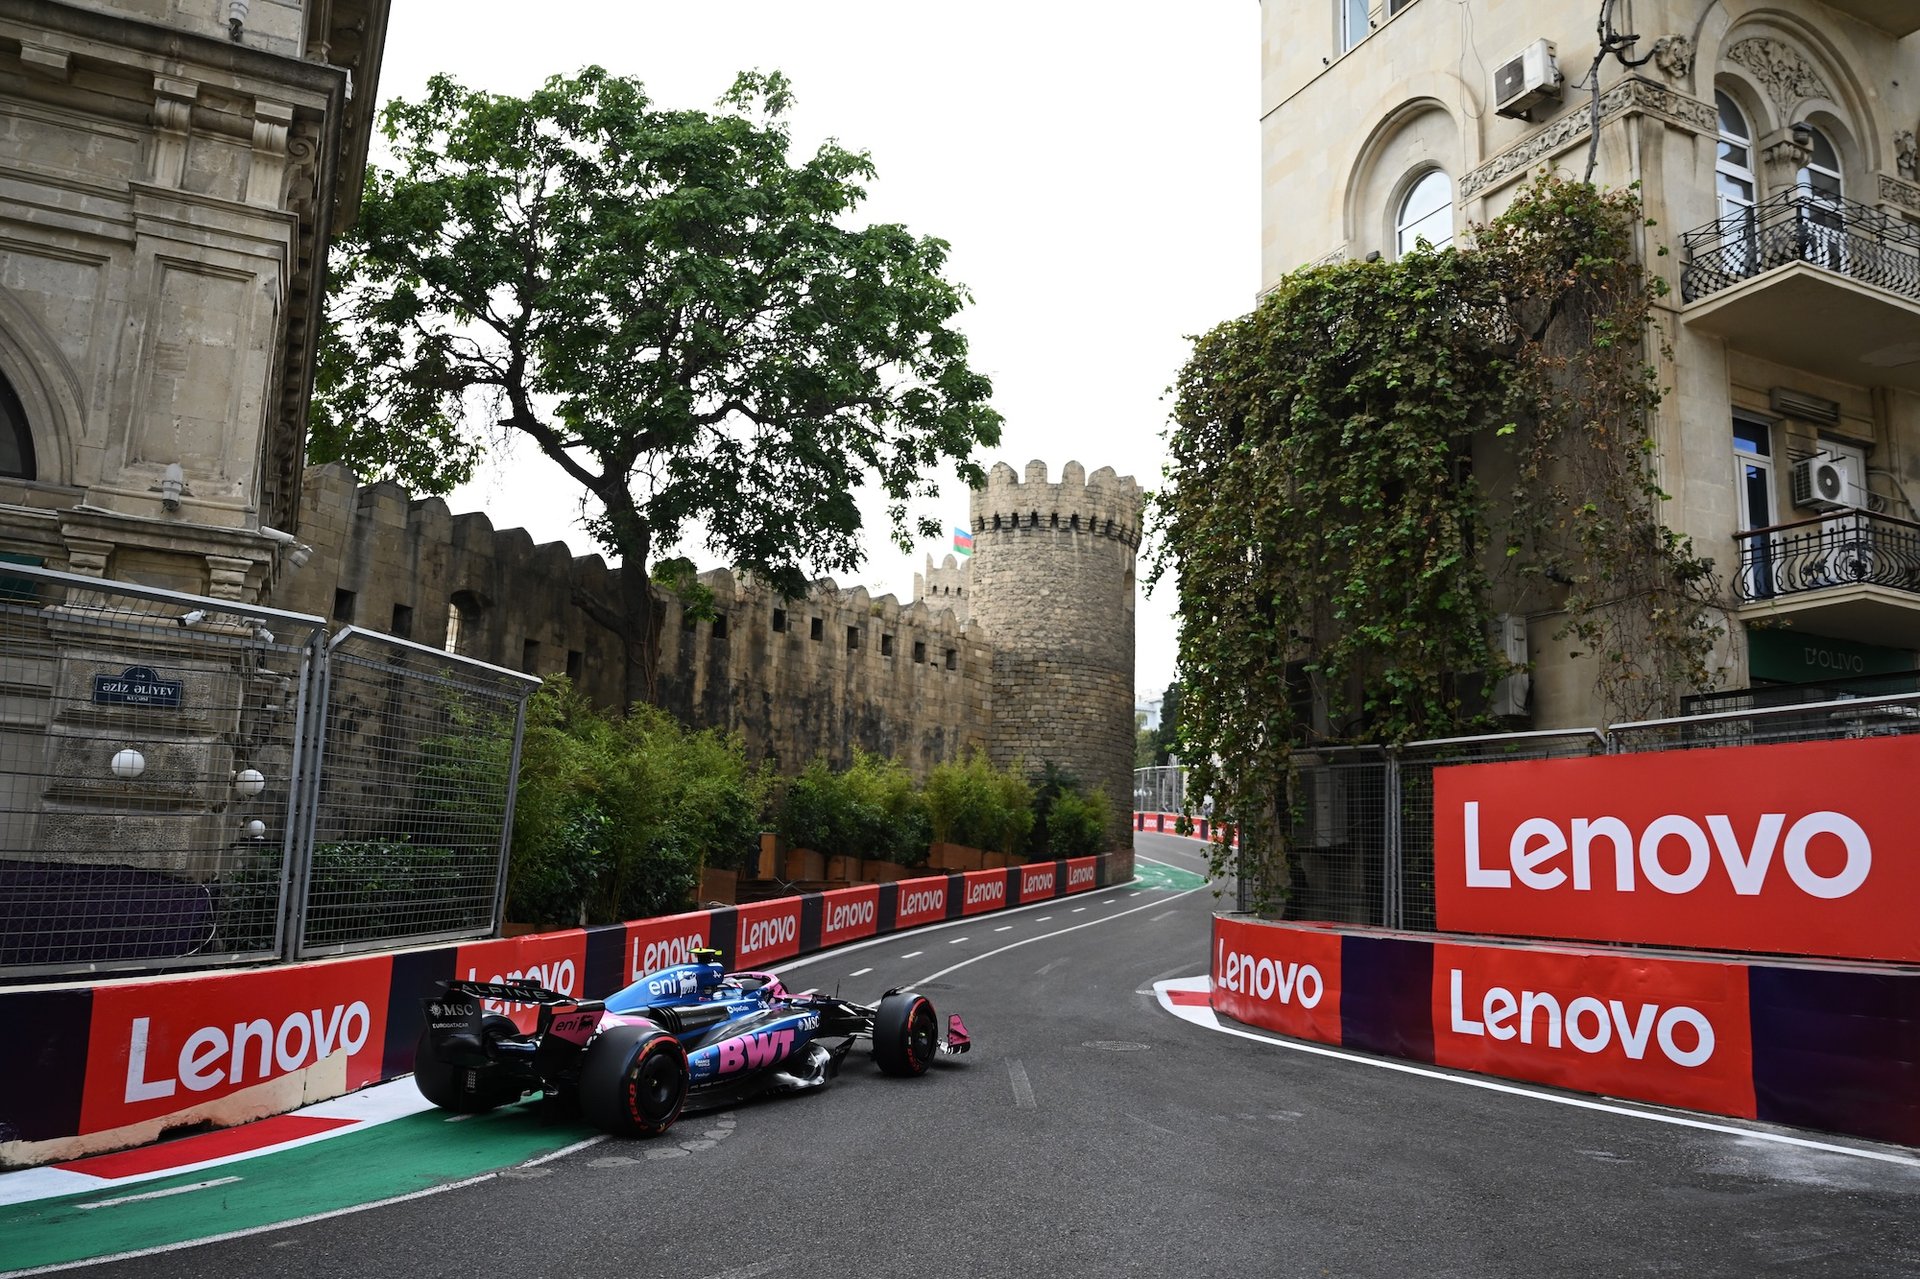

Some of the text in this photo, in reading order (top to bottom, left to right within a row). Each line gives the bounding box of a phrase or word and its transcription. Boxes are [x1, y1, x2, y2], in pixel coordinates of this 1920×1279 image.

[1805, 647, 1864, 673] D'OLIVO
[102, 682, 175, 696] ƏZİZ ƏLİYEV
[1464, 800, 1872, 899] Lenovo
[1022, 872, 1053, 894] Lenovo
[1068, 866, 1095, 885] Lenovo
[900, 888, 944, 916] Lenovo
[966, 880, 1003, 905] Lenovo
[825, 900, 874, 933] Lenovo
[740, 913, 796, 954] Lenovo
[632, 933, 703, 981] Lenovo
[649, 975, 676, 996] eni
[1217, 938, 1323, 1009] Lenovo
[462, 984, 549, 1000] ALPINE
[444, 1004, 474, 1016] MSC
[1450, 968, 1715, 1067] Lenovo
[555, 1017, 579, 1032] eni
[804, 1016, 820, 1031] MSC
[124, 1000, 371, 1104] Lenovo
[718, 1029, 795, 1073] BWT
